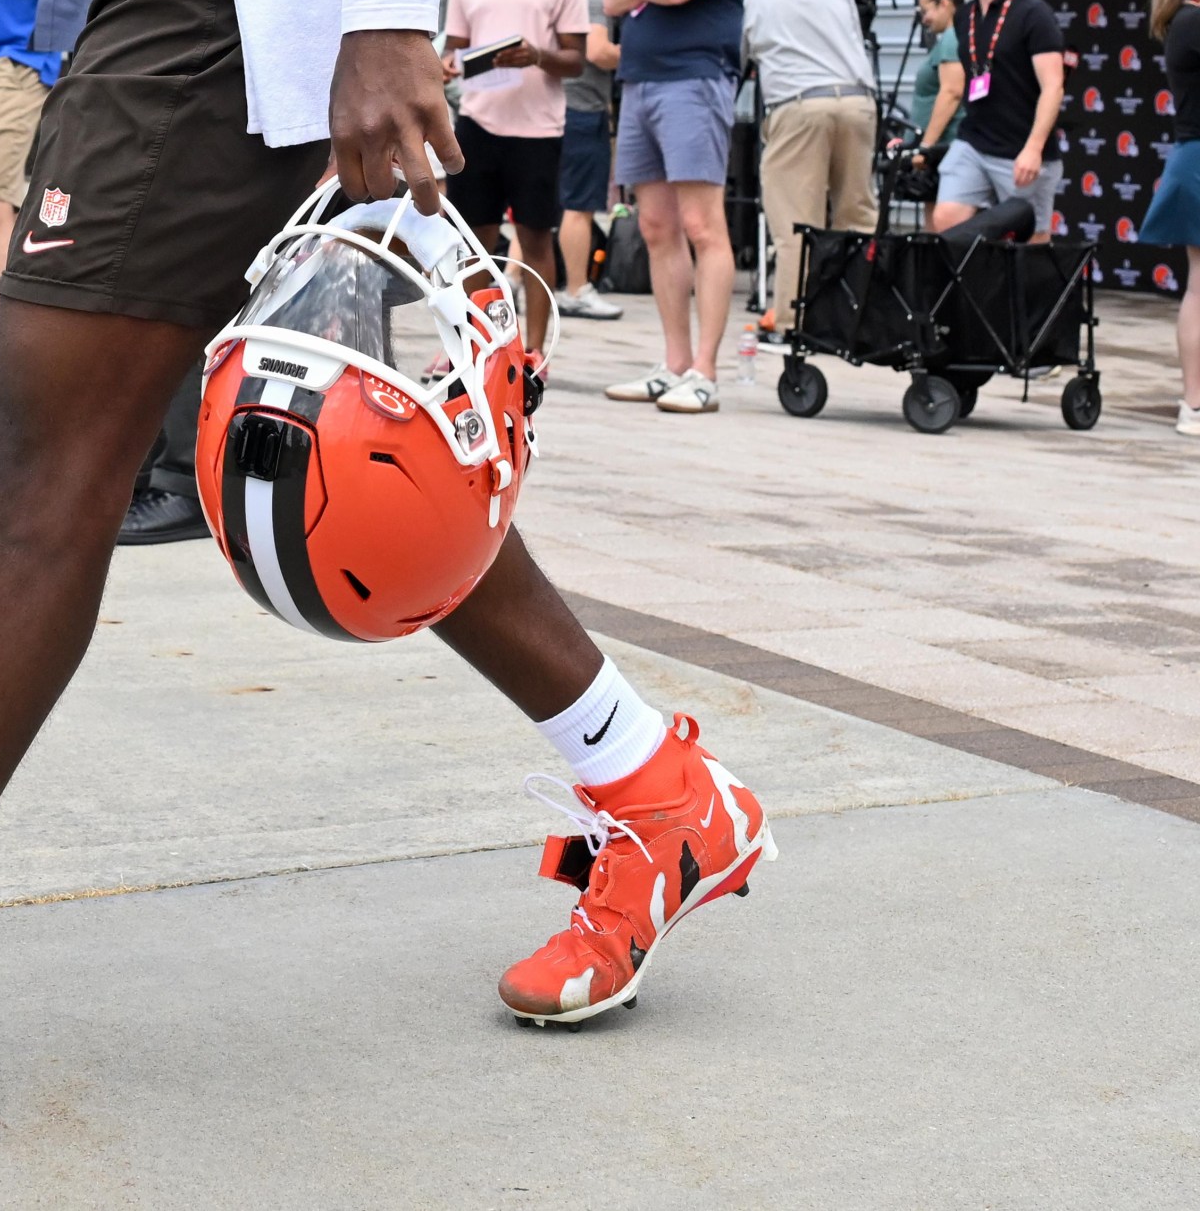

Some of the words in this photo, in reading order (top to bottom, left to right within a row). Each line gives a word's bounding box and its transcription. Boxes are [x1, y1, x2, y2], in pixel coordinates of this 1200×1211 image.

[44, 202, 65, 221] NFL
[258, 357, 308, 379] BROWNS
[368, 376, 417, 410] OAKLEY
